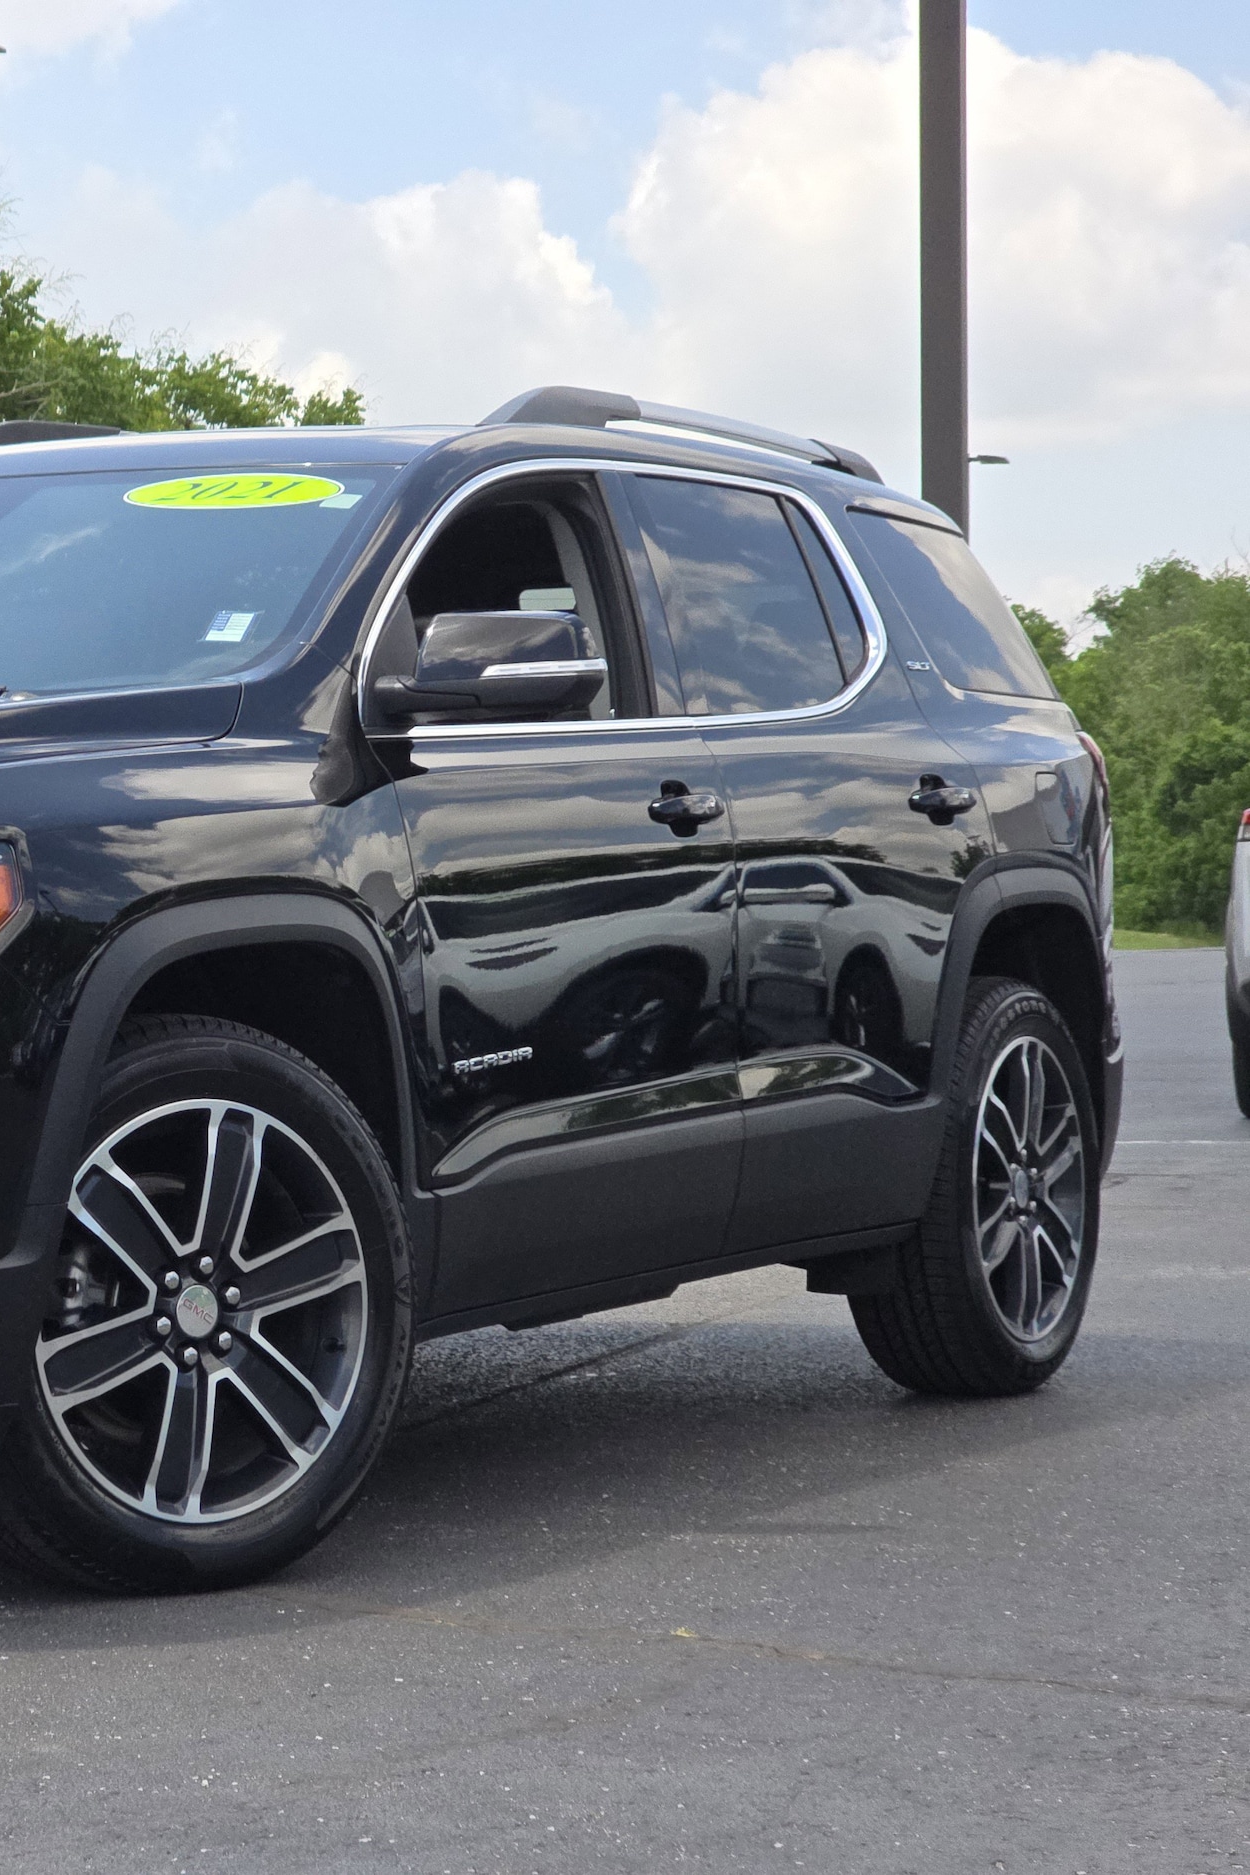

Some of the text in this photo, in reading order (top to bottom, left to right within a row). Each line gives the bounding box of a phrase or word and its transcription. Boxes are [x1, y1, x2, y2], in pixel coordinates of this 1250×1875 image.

[152, 480, 305, 502] 2021
[453, 1046, 533, 1075] ACADIA
[183, 1298, 214, 1325] GMC
